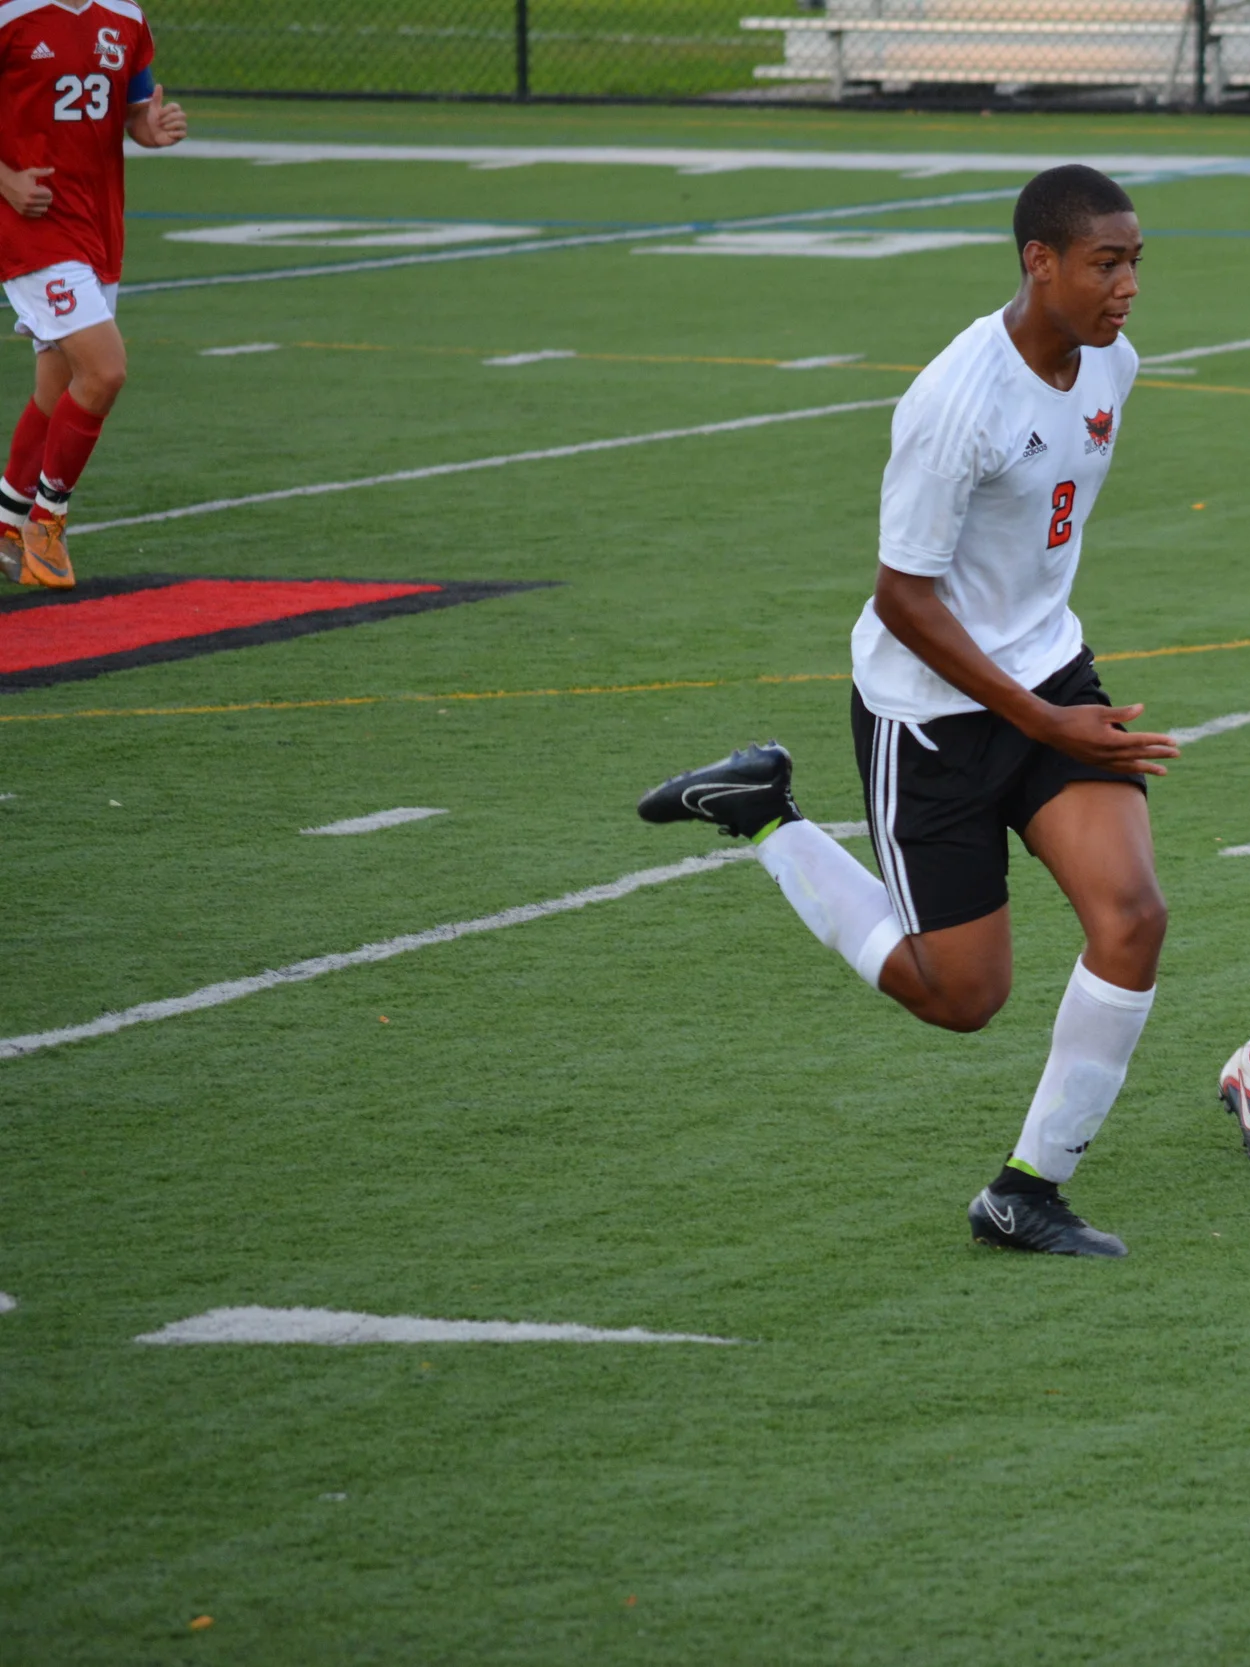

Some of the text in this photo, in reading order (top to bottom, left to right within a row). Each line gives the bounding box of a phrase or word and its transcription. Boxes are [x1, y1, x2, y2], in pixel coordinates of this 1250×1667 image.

[98, 27, 125, 71] S
[53, 73, 112, 121] 23
[45, 278, 77, 318] S
[1022, 443, 1048, 458] adidas
[1046, 479, 1077, 550] 2
